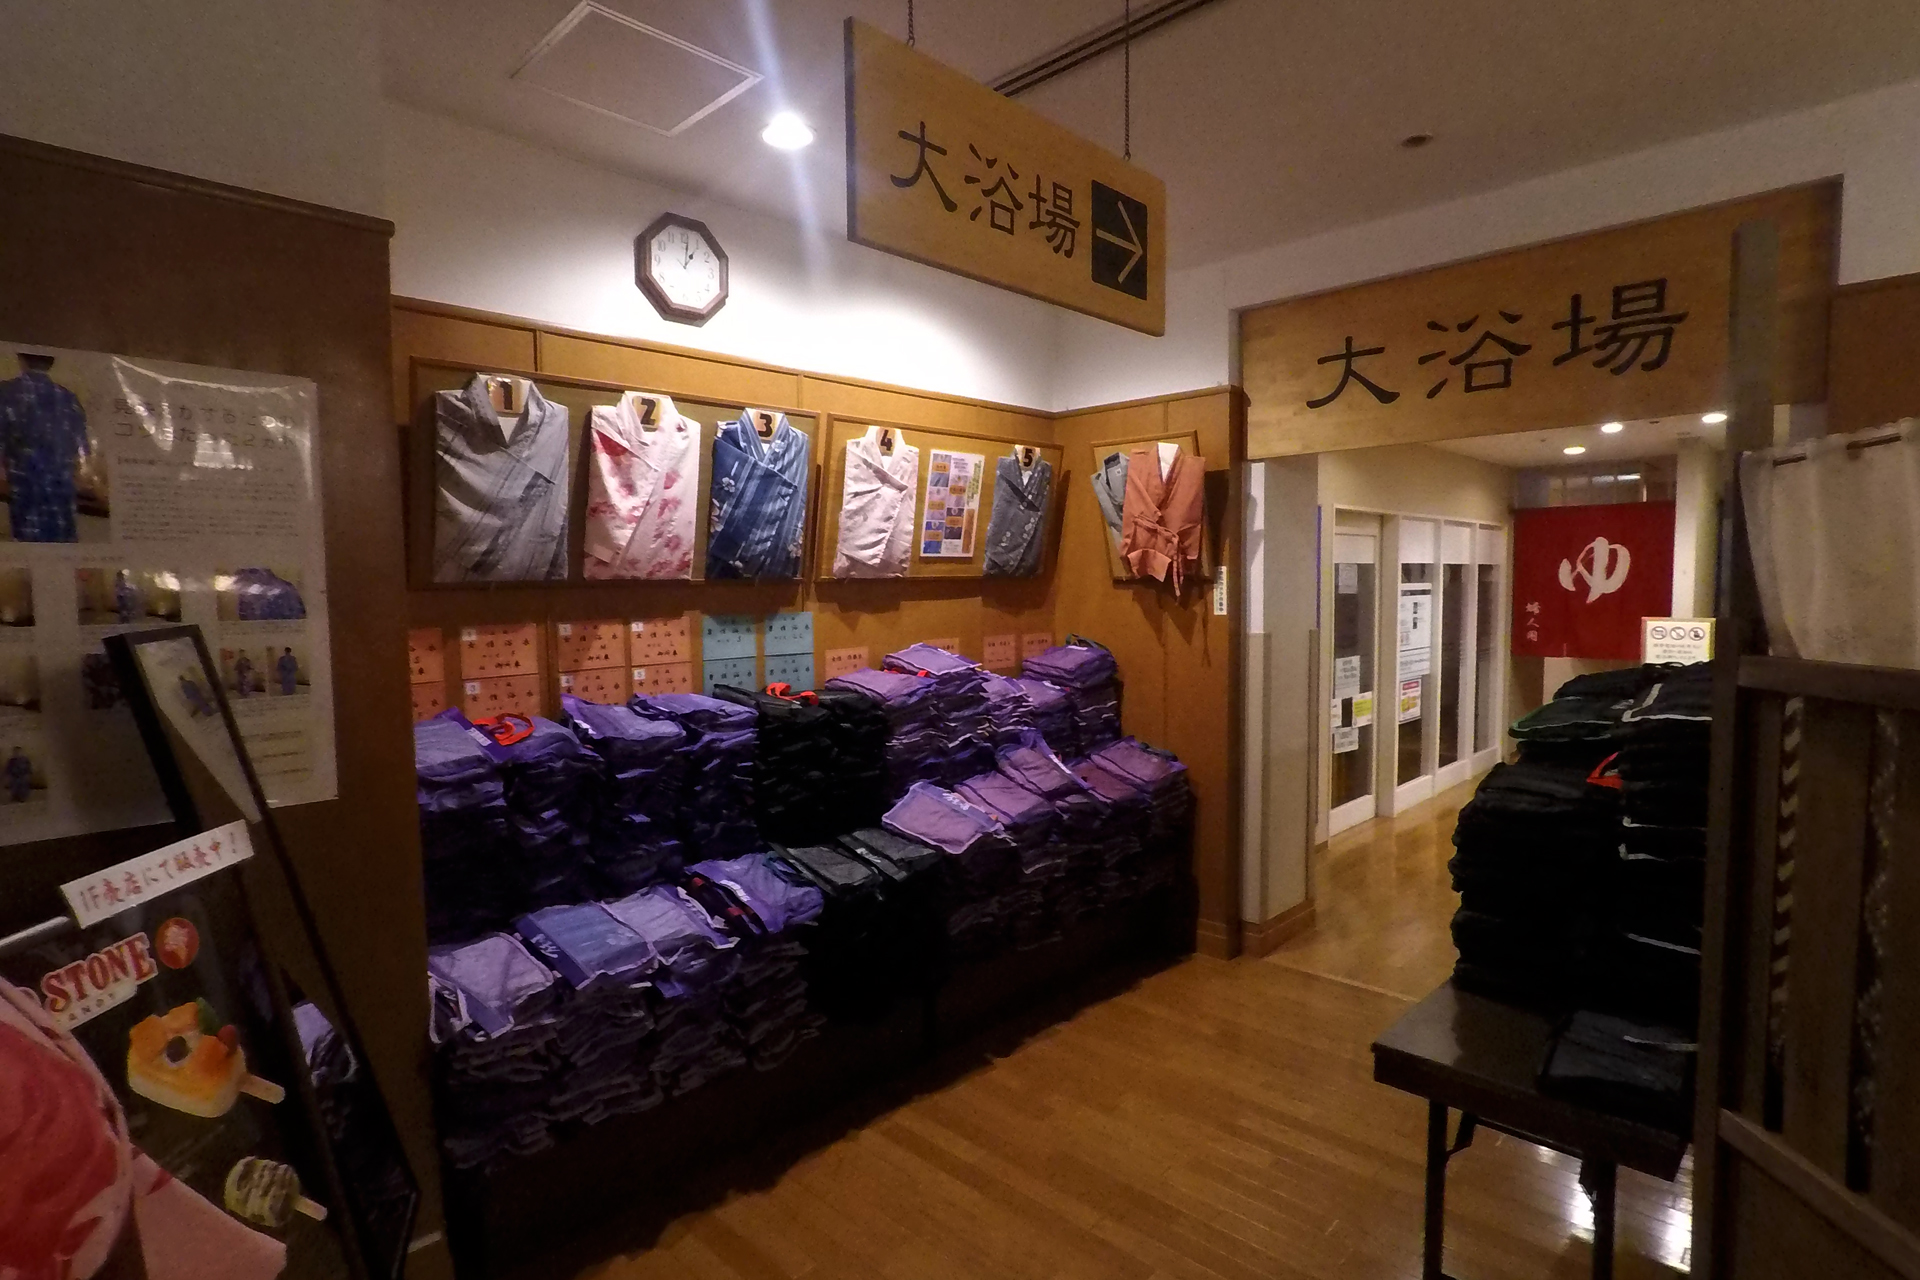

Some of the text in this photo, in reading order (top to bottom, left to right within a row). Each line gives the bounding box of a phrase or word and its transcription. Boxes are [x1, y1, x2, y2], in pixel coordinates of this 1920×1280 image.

[890, 121, 1081, 259] 大浴場
[1306, 278, 1690, 410] 大浴場
[498, 380, 514, 412] 1
[641, 398, 658, 426] 2
[758, 412, 774, 437] 3
[880, 429, 892, 452] 4
[1023, 447, 1034, 468] 5
[1558, 536, 1631, 604] ゆ
[46, 936, 154, 1012] STONE
